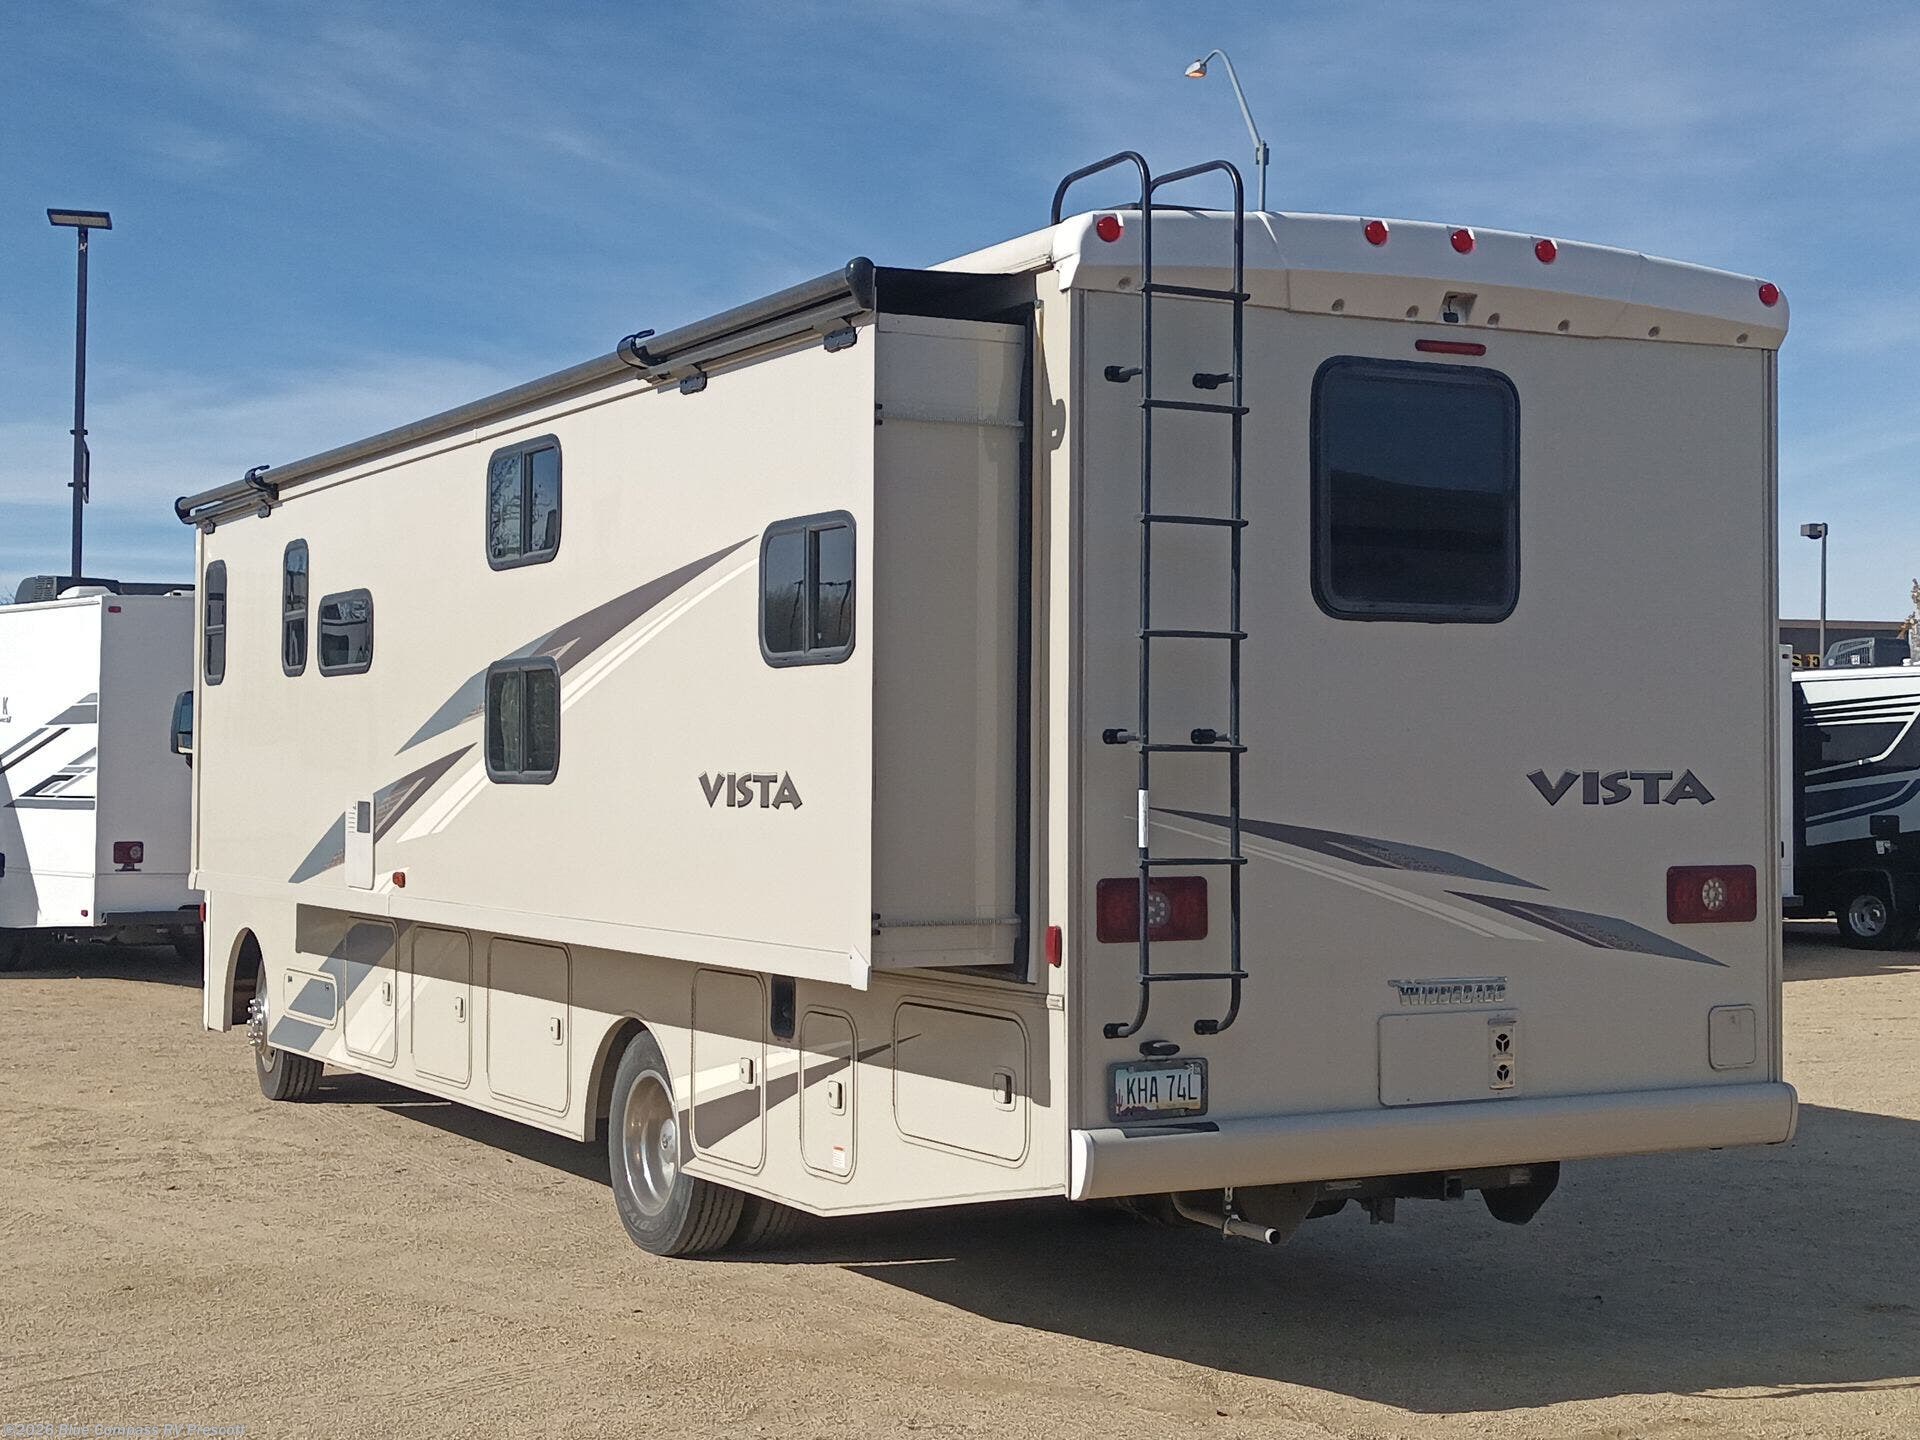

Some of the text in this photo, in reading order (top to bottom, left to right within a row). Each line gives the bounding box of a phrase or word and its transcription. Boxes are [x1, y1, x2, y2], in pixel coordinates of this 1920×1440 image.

[698, 770, 803, 810] VISTA
[1526, 768, 1716, 807] VISTA
[1126, 1073, 1198, 1105] KHA 74L
